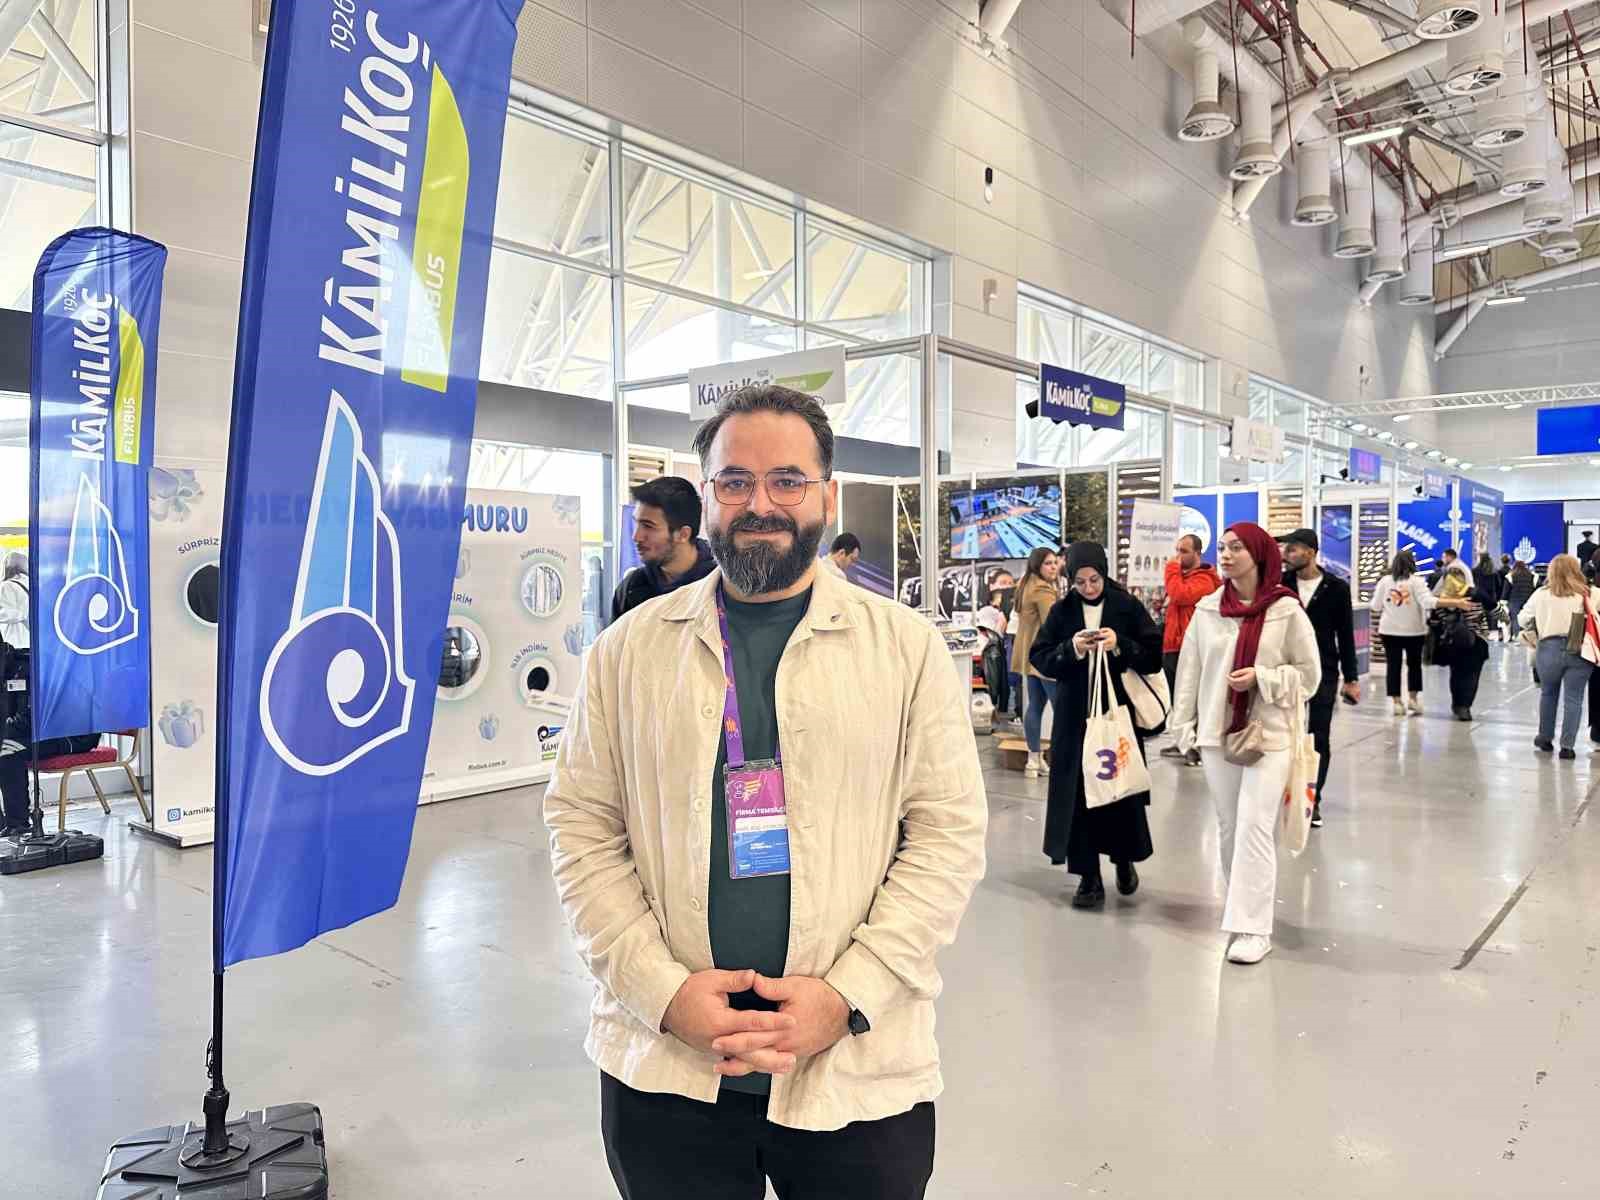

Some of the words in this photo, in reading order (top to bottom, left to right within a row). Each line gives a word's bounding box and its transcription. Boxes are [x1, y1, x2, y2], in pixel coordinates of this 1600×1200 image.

[329, 0, 358, 52] 1926
[124, 397, 137, 455] FLIXBUS
[178, 537, 220, 554] SÜRPRİZ
